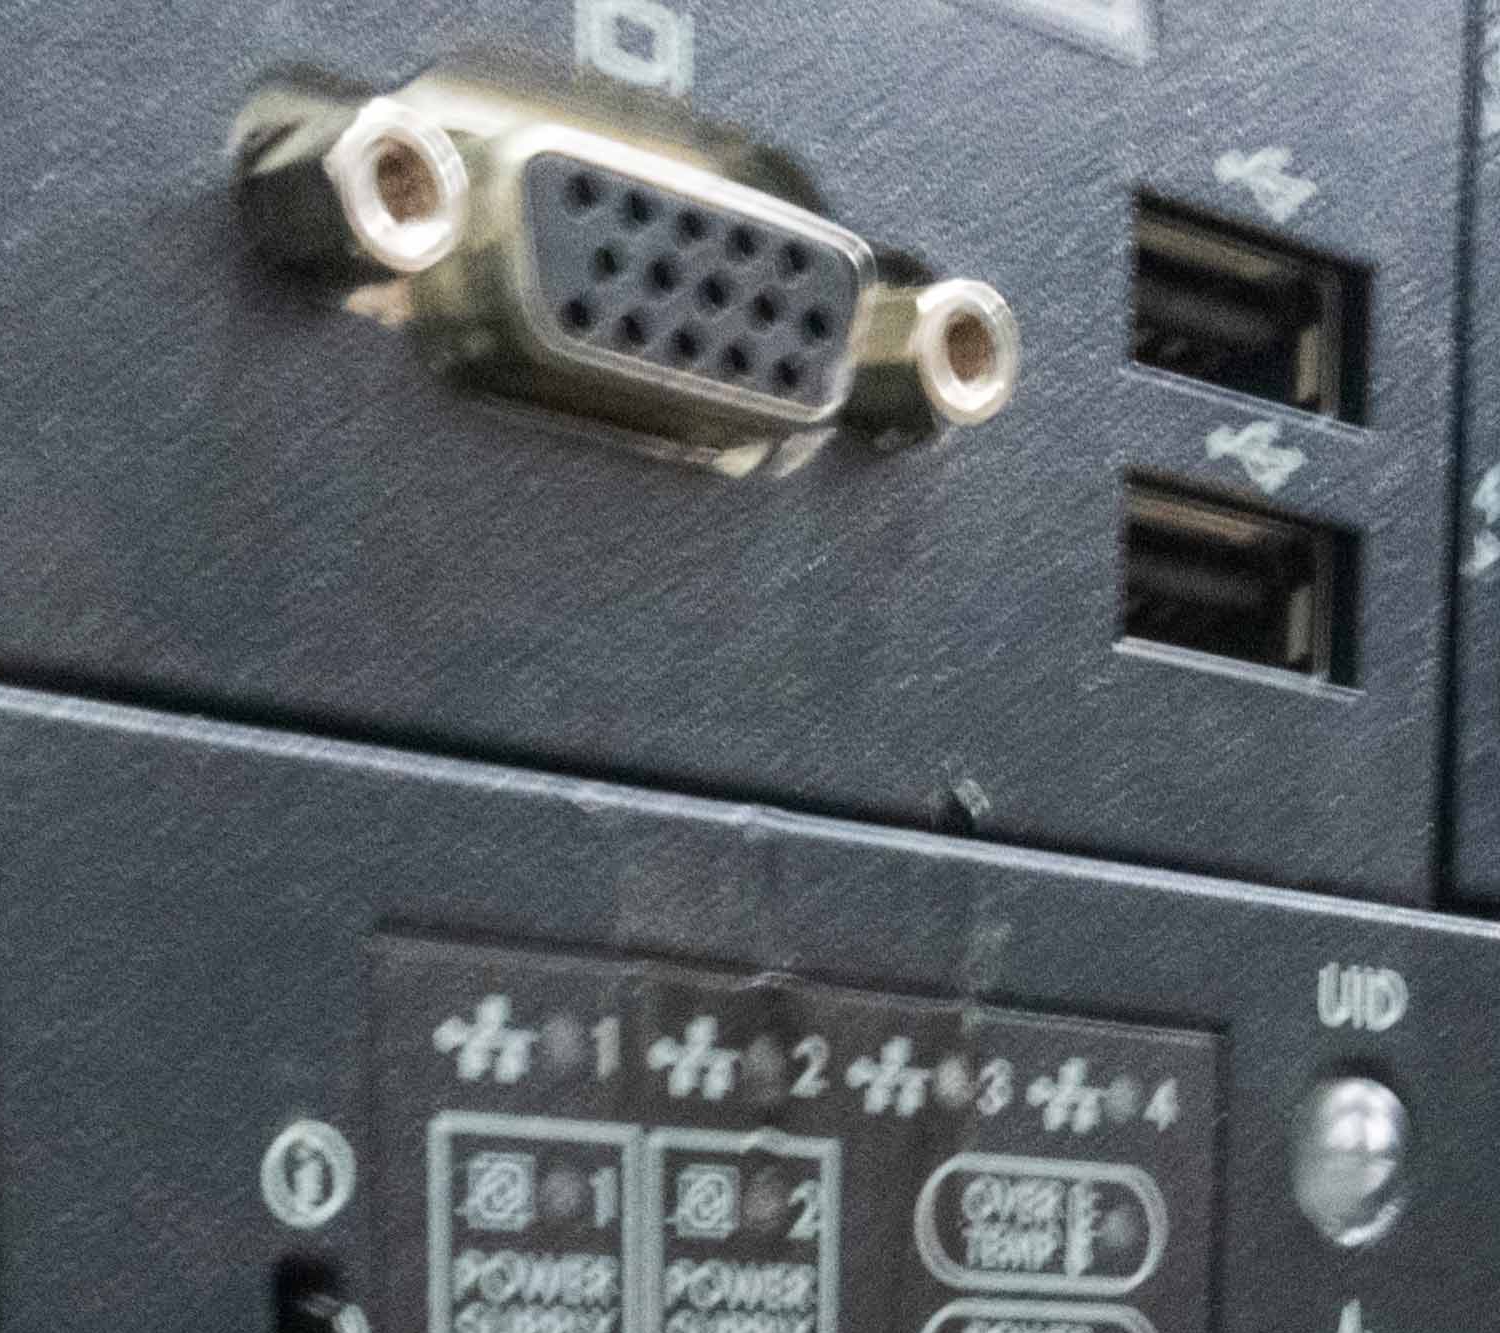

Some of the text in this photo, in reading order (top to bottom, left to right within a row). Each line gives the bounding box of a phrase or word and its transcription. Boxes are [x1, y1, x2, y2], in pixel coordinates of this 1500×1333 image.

[1317, 960, 1410, 1032] UID
[590, 1016, 1181, 1133] 1 2 3 4
[590, 1167, 618, 1229] 1
[787, 1180, 822, 1240] 2
[961, 1176, 1066, 1227] OVER
[453, 1250, 618, 1303] POWER
[961, 1226, 1060, 1271] TEMP
[664, 1258, 820, 1311] POWER
